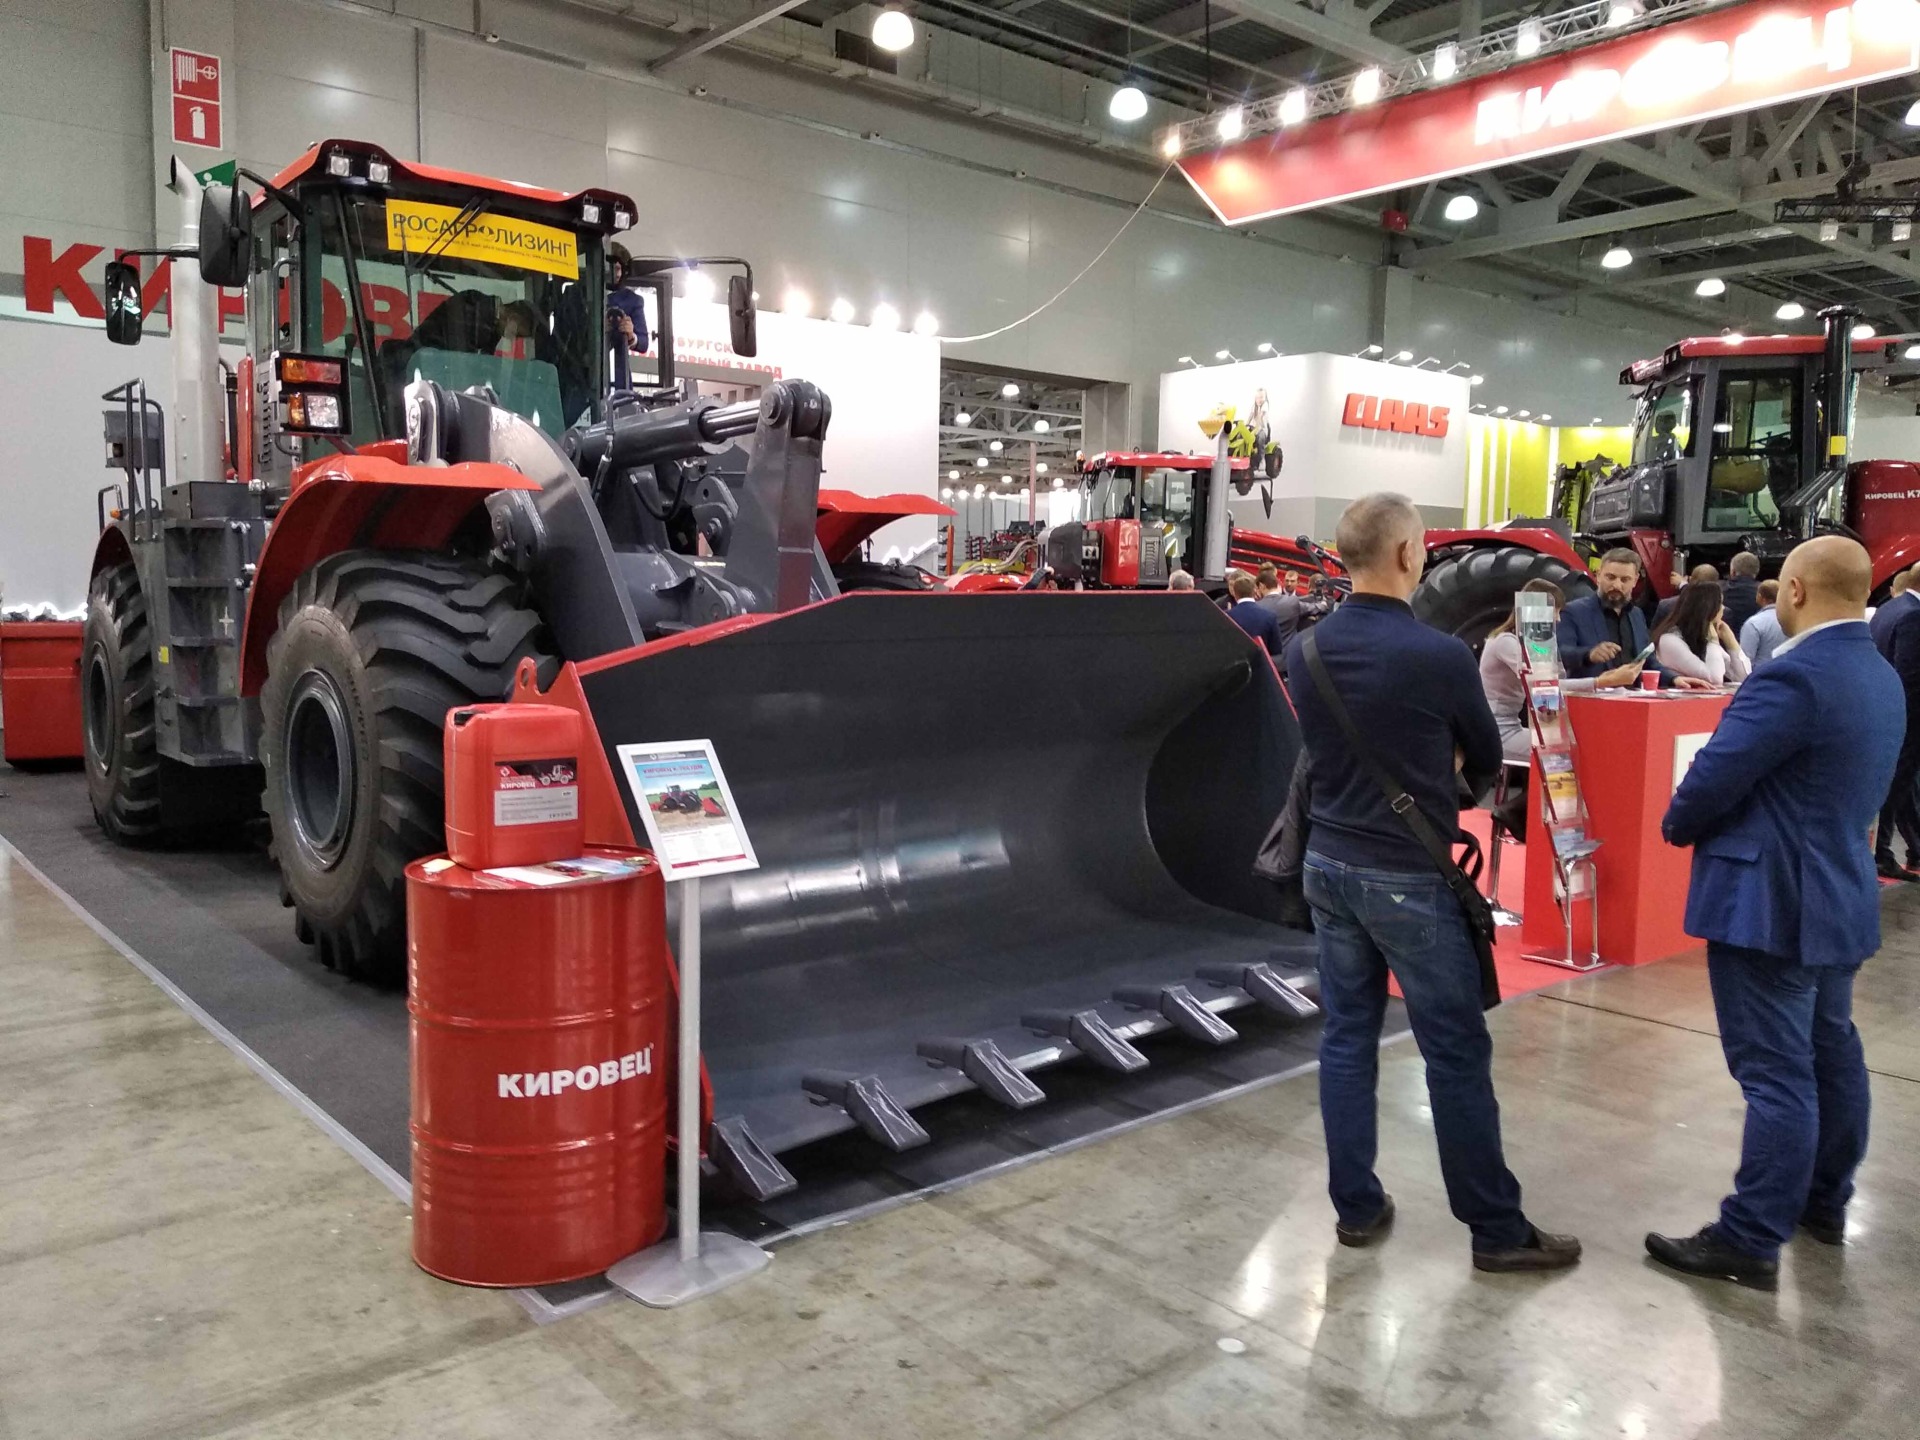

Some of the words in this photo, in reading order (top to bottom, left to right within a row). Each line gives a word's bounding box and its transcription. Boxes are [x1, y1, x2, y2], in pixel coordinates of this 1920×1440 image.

[1342, 393, 1450, 438] CLAAS
[1864, 492, 1905, 500] КИРОВЕЦ
[500, 781, 536, 790] КИРОВЕЦ
[497, 1046, 652, 1098] КИРОВЕЦ
